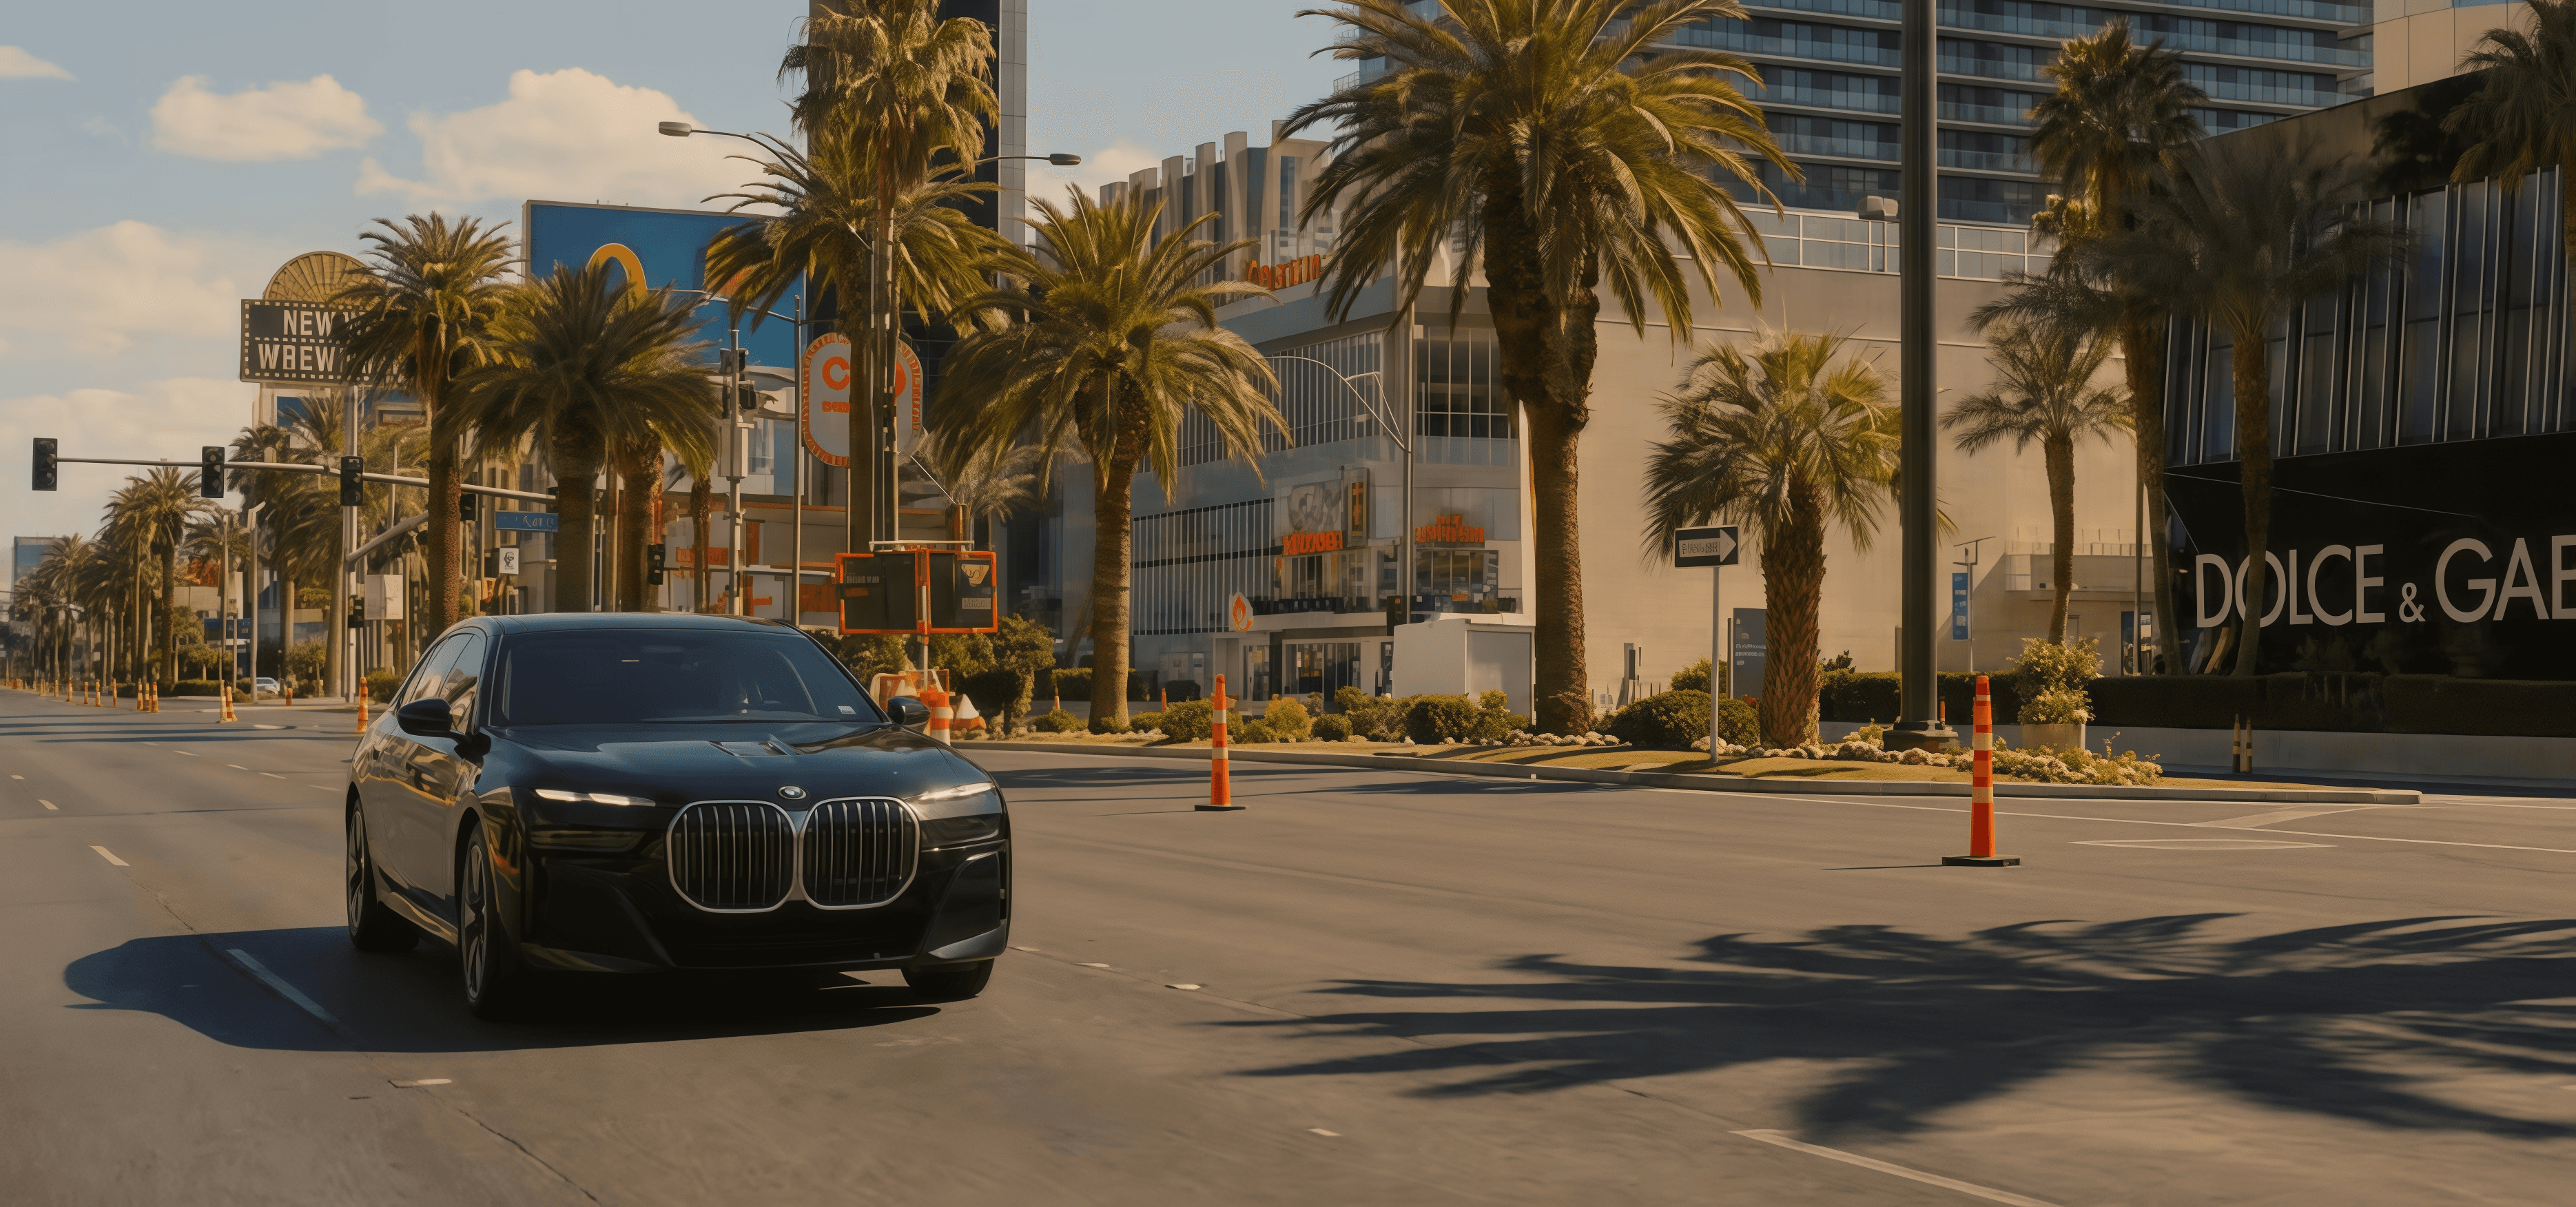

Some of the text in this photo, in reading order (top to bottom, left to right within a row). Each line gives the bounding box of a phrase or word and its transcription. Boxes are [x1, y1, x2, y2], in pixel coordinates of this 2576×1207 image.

[283, 309, 336, 336] NEW
[2196, 544, 2386, 628] DOLCE
[2398, 582, 2426, 623] &
